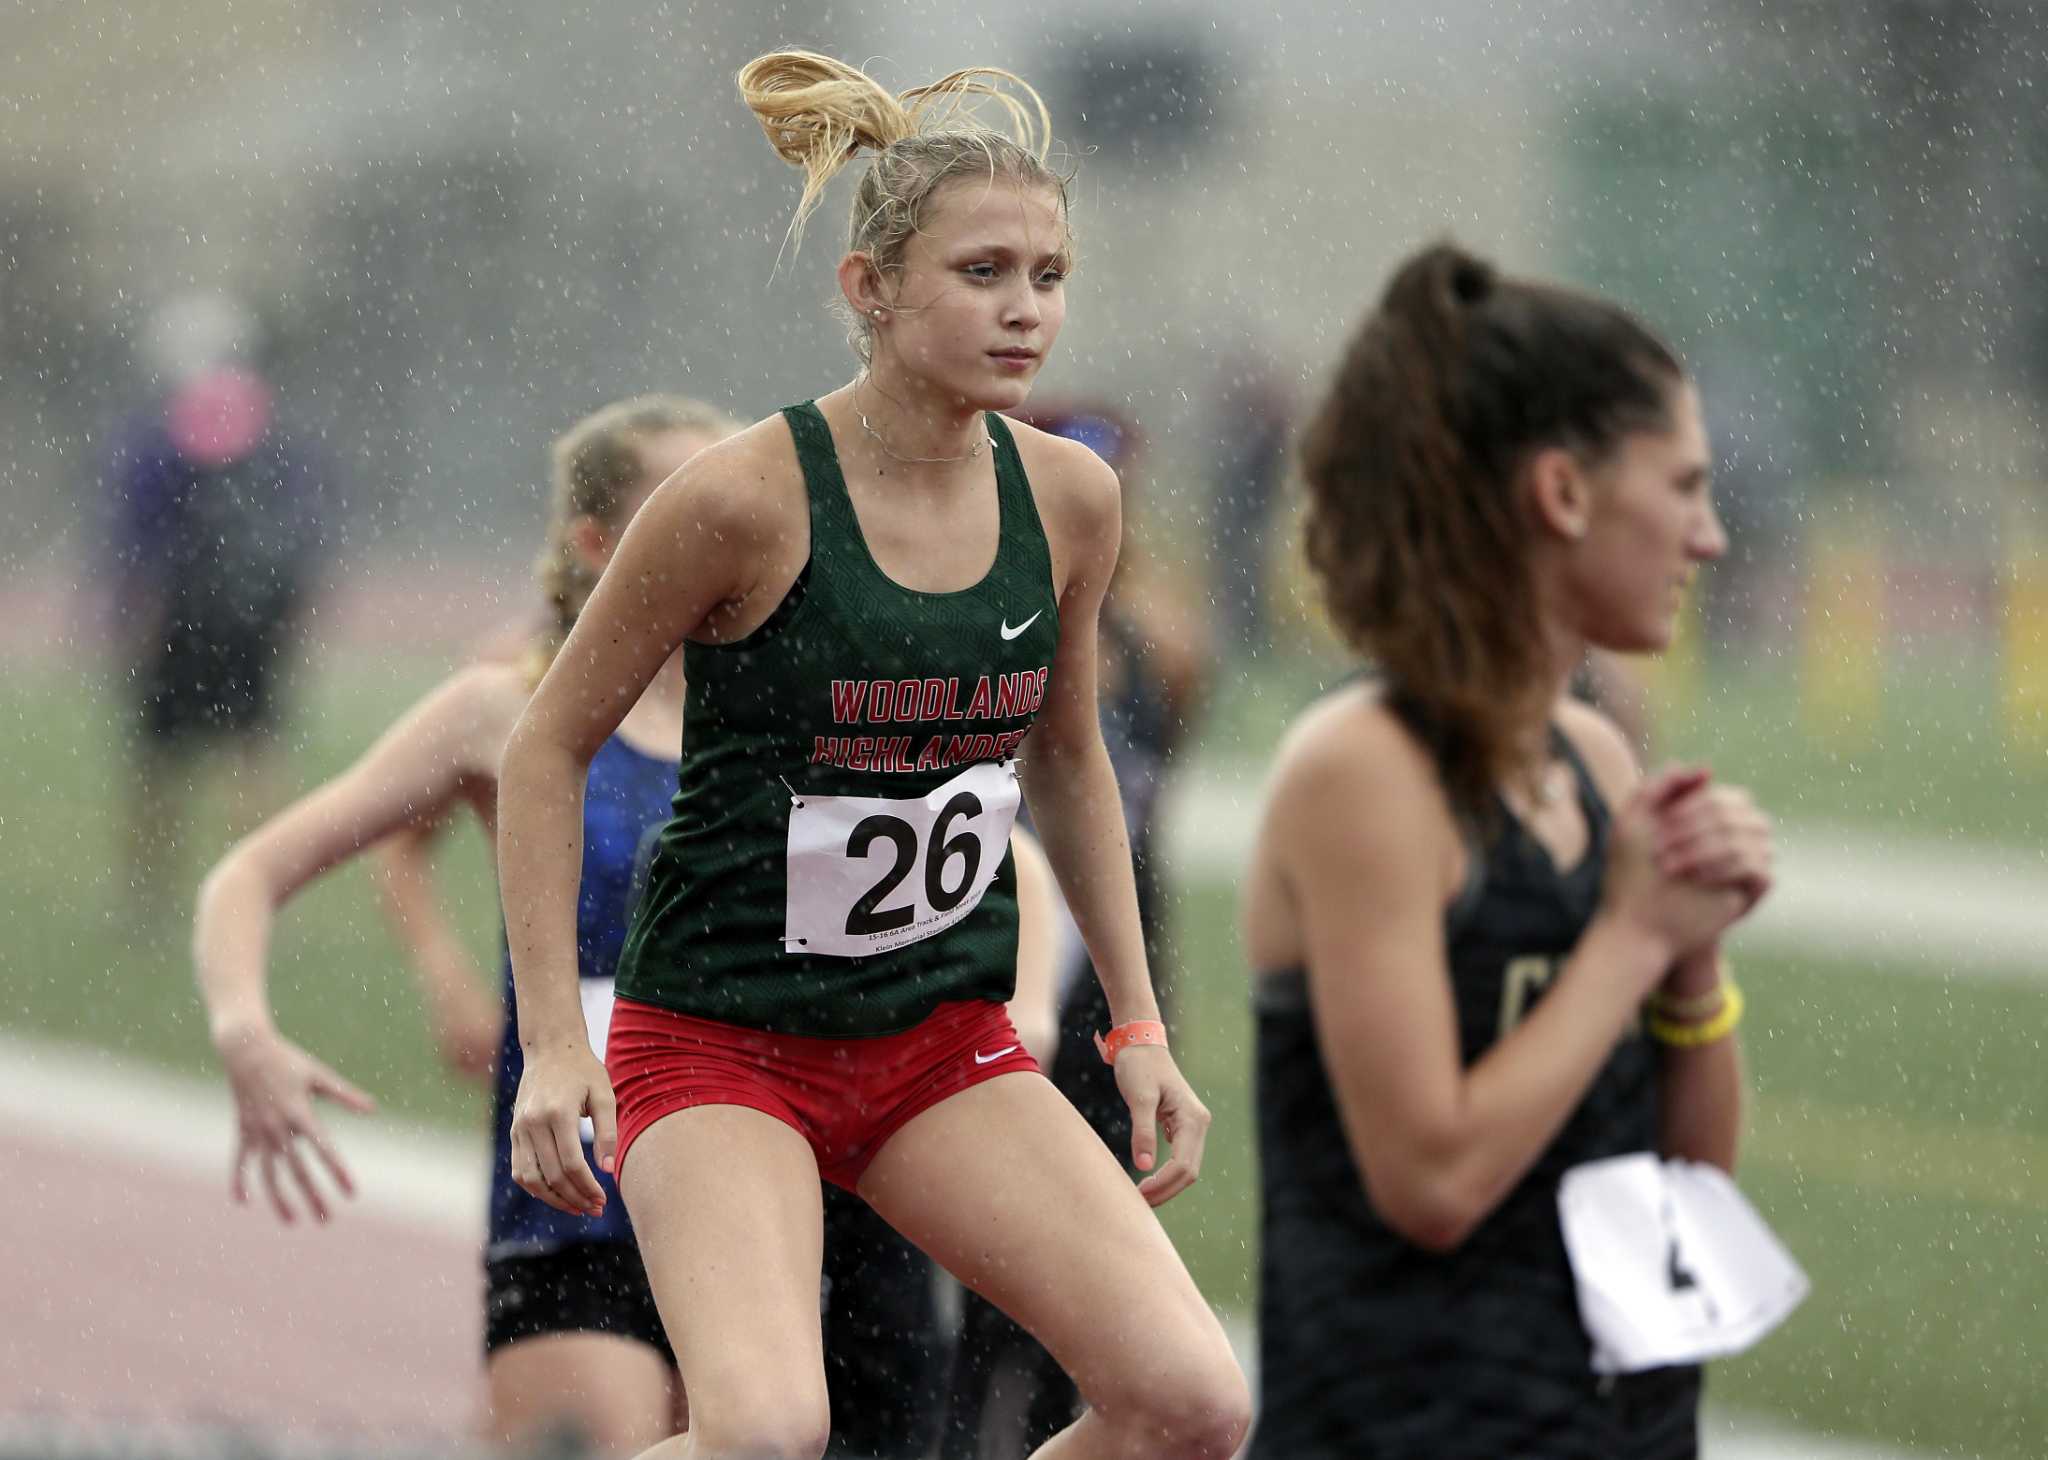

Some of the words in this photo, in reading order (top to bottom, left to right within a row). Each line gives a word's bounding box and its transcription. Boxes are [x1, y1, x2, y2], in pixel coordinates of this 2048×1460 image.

[831, 667, 1047, 724] WOODLANDS
[811, 725, 1031, 773] HIGHLANDER
[845, 791, 983, 935] 26
[868, 931, 889, 941] 15-16
[889, 929, 900, 937] 6A
[900, 924, 916, 934] Area
[916, 917, 933, 928] Track
[934, 914, 940, 922] &
[875, 944, 893, 953] Klein
[894, 933, 925, 947] Memorial
